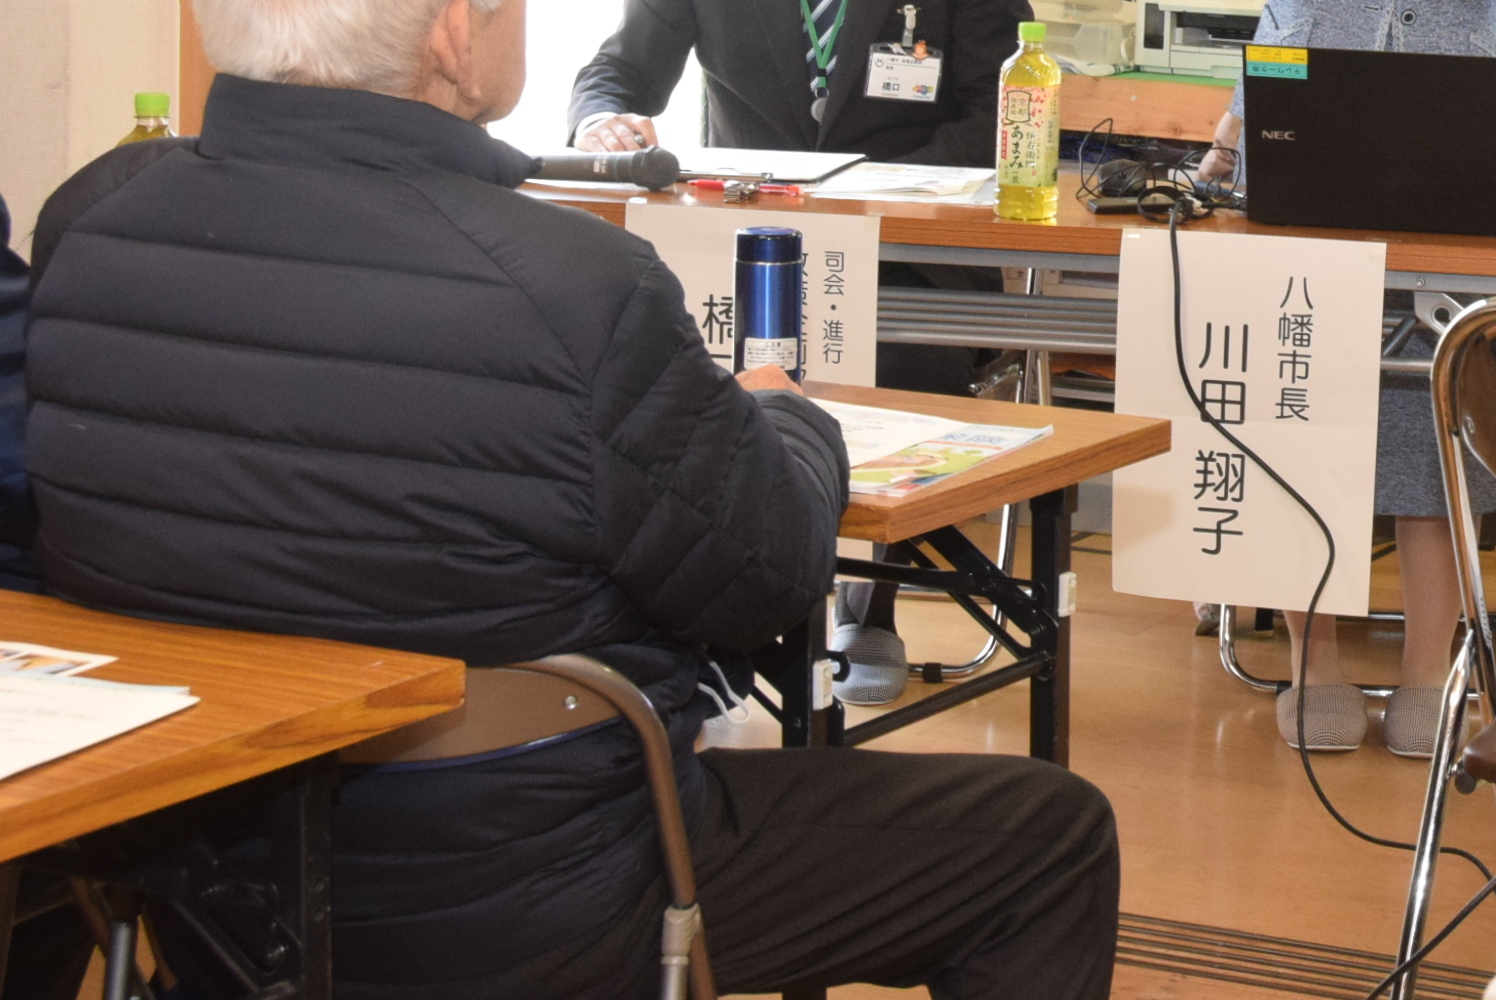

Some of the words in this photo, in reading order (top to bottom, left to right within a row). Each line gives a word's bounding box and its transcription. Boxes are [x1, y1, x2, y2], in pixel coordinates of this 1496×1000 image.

[1252, 66, 1300, 74] テレワーク用
[883, 82, 900, 91] 橋口
[1262, 130, 1295, 140] NEC
[822, 251, 845, 365] 司会・進行
[1275, 276, 1314, 422] 八幡市長
